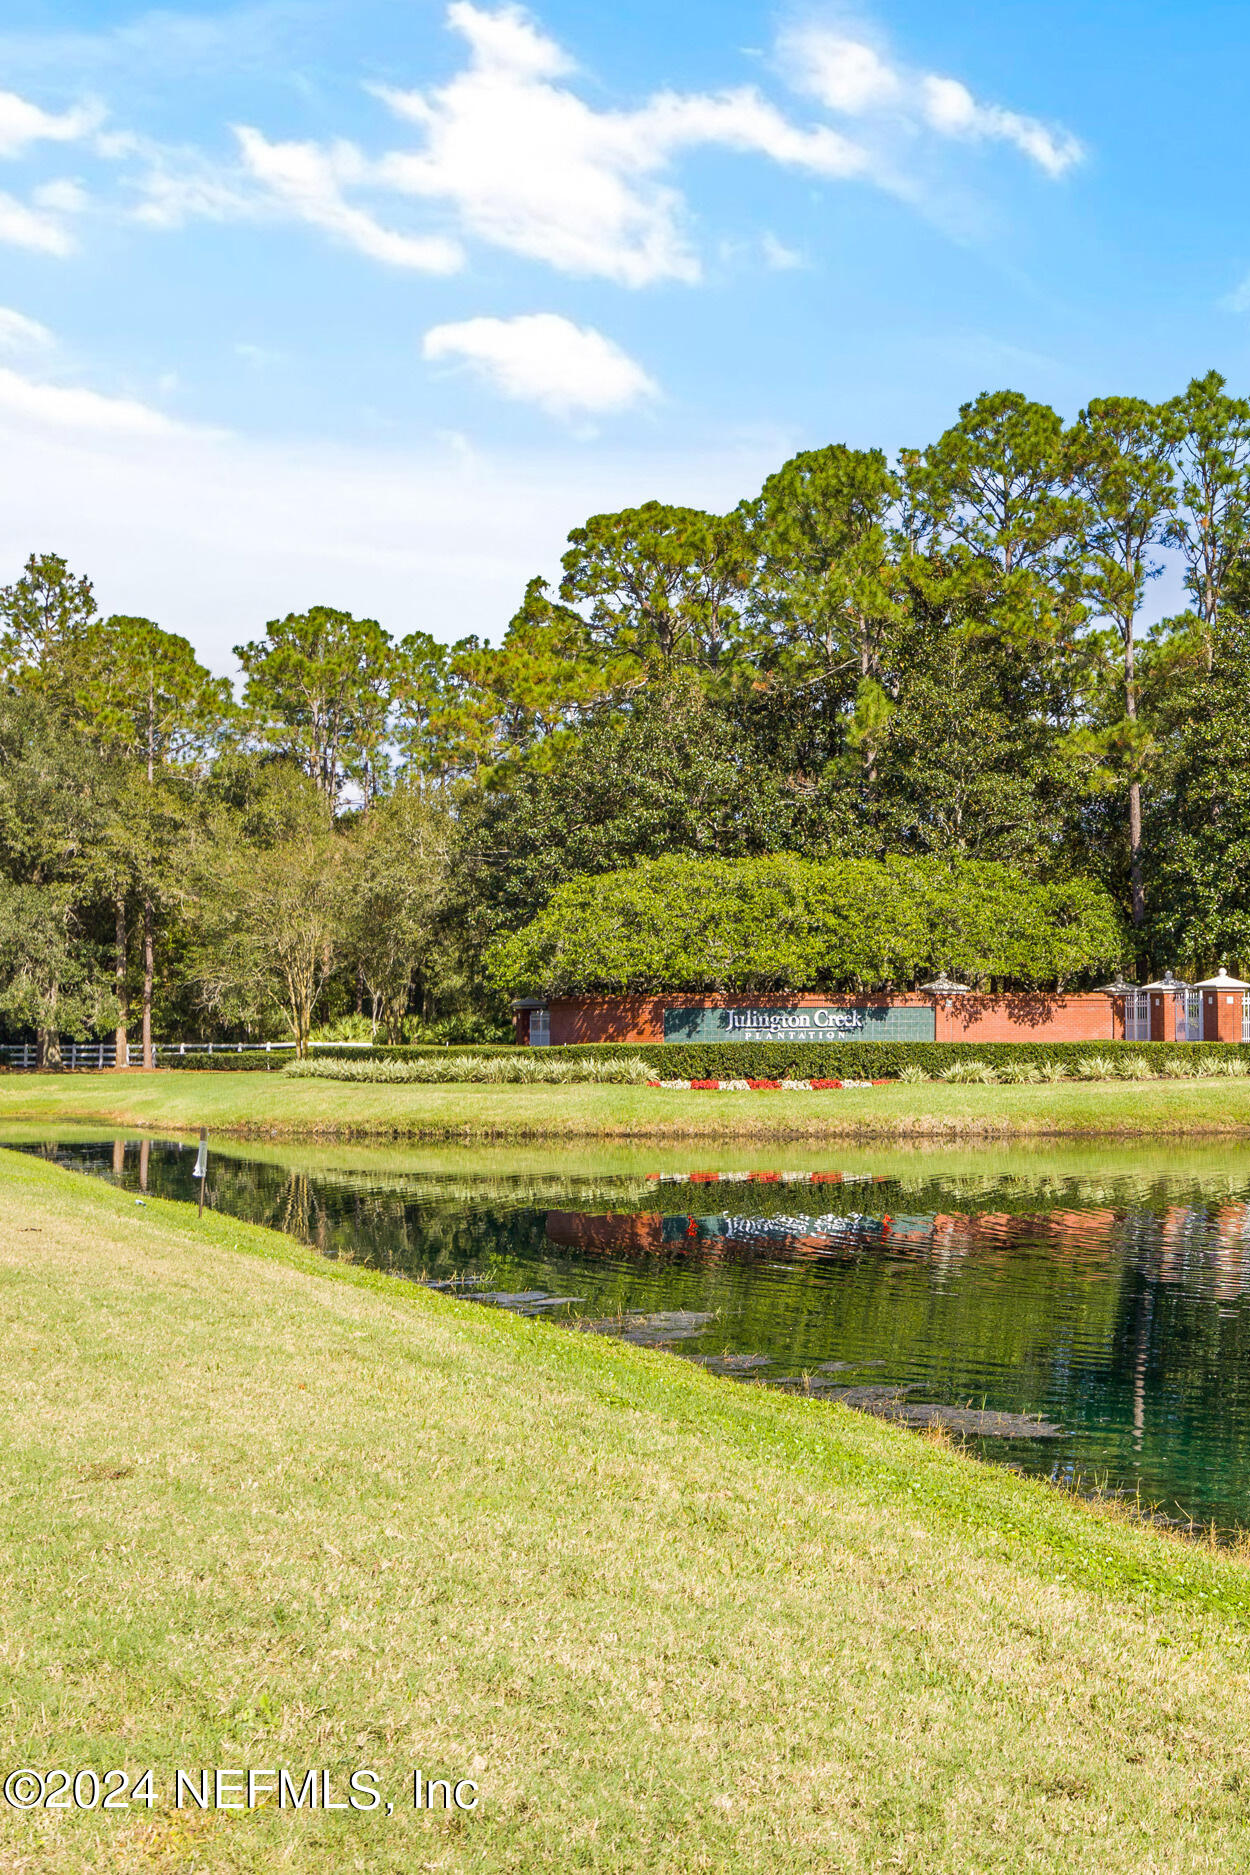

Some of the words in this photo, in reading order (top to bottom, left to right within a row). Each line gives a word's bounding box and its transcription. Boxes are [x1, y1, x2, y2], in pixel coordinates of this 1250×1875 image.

[726, 1010, 811, 1032] Julington
[814, 1010, 862, 1027] Creek
[745, 1032, 846, 1040] PLANTATION
